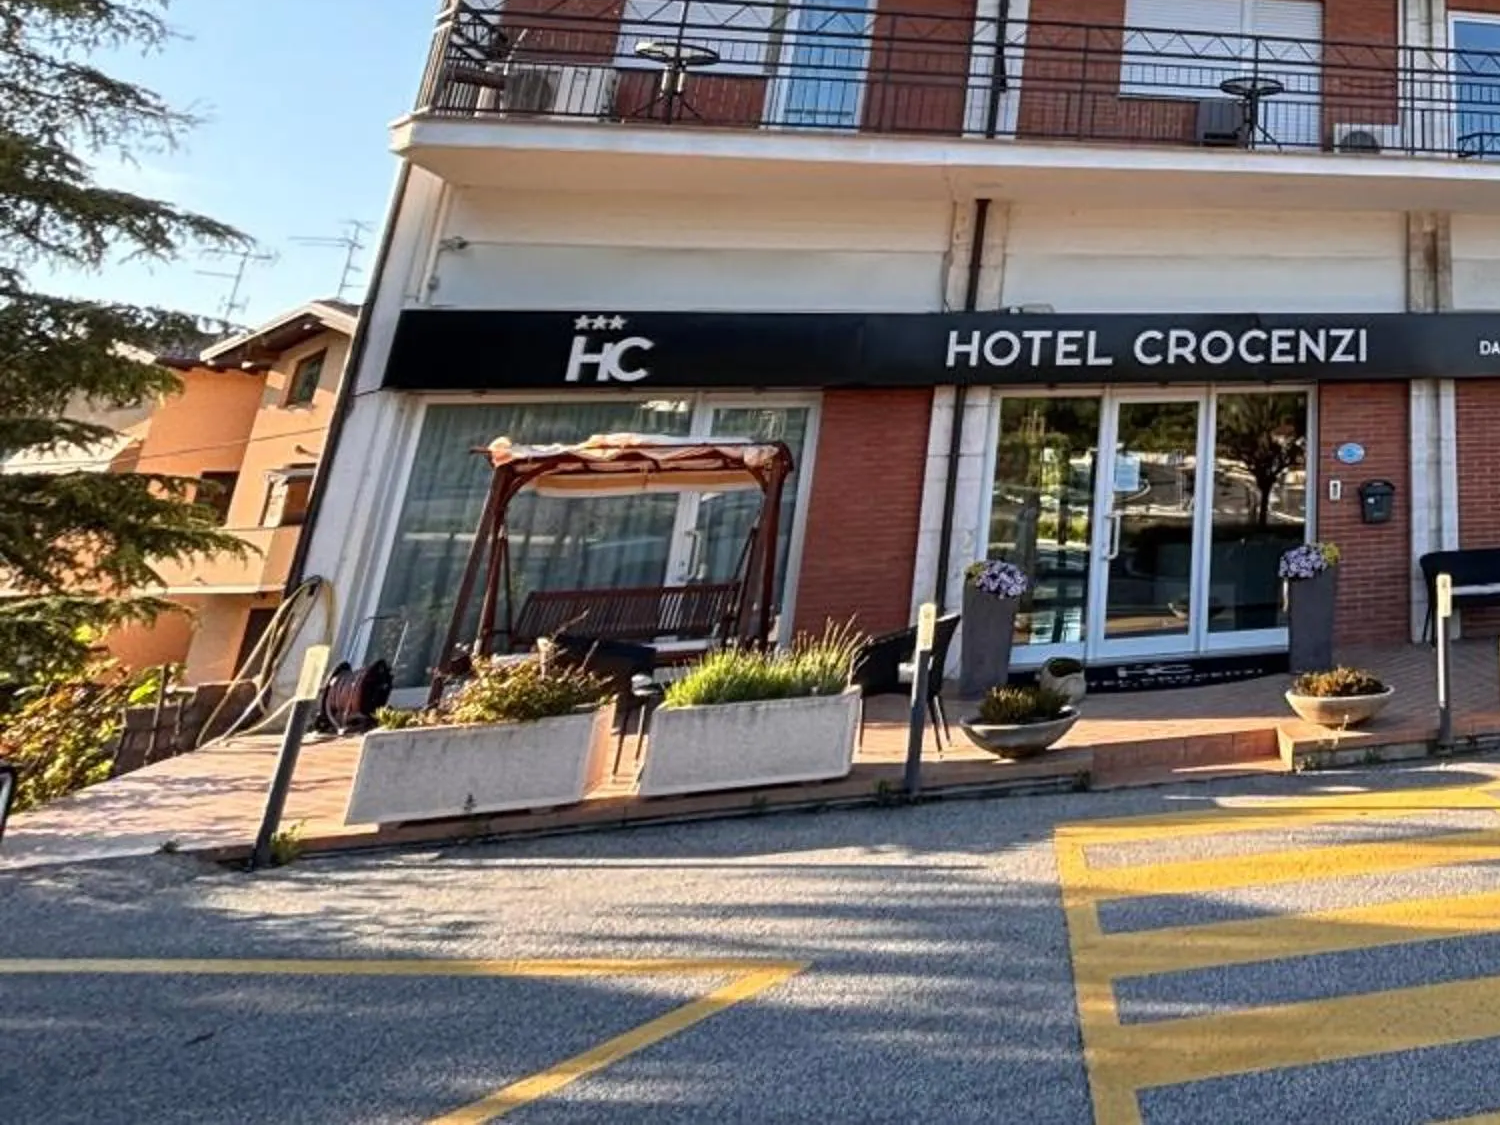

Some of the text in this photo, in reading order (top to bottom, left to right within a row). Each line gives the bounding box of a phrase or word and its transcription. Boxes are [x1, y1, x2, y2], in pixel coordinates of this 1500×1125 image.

[565, 335, 655, 382] HC
[946, 328, 1368, 367] HOTEL CROCENZI
